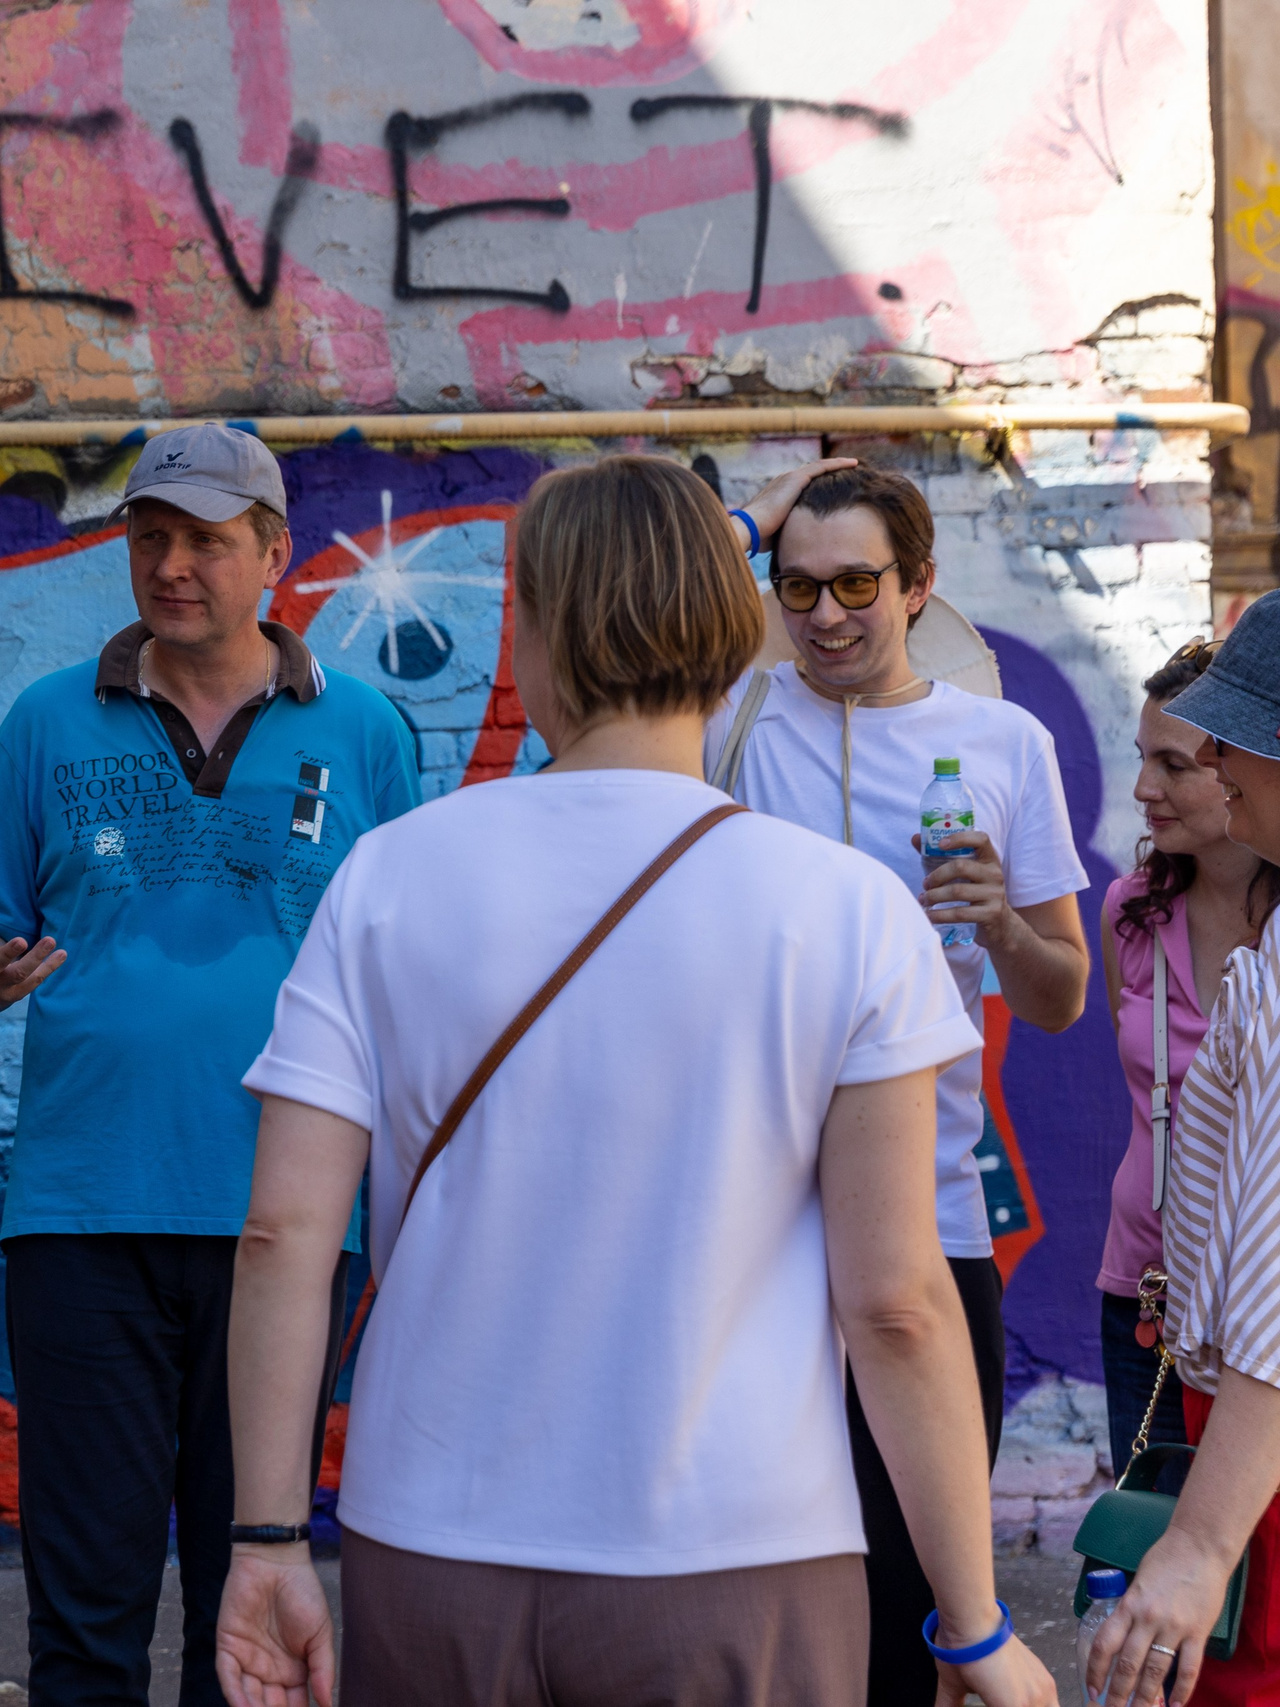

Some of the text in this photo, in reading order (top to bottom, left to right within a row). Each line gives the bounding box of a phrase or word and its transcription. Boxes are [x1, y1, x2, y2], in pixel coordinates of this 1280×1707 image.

[54, 751, 174, 785] OUTDOOR
[56, 772, 178, 806] WORLD
[61, 793, 181, 831] TRAVEL
[161, 825, 197, 842] Road
[119, 865, 176, 877] Welcome
[182, 861, 200, 870] to
[132, 852, 166, 869] Road
